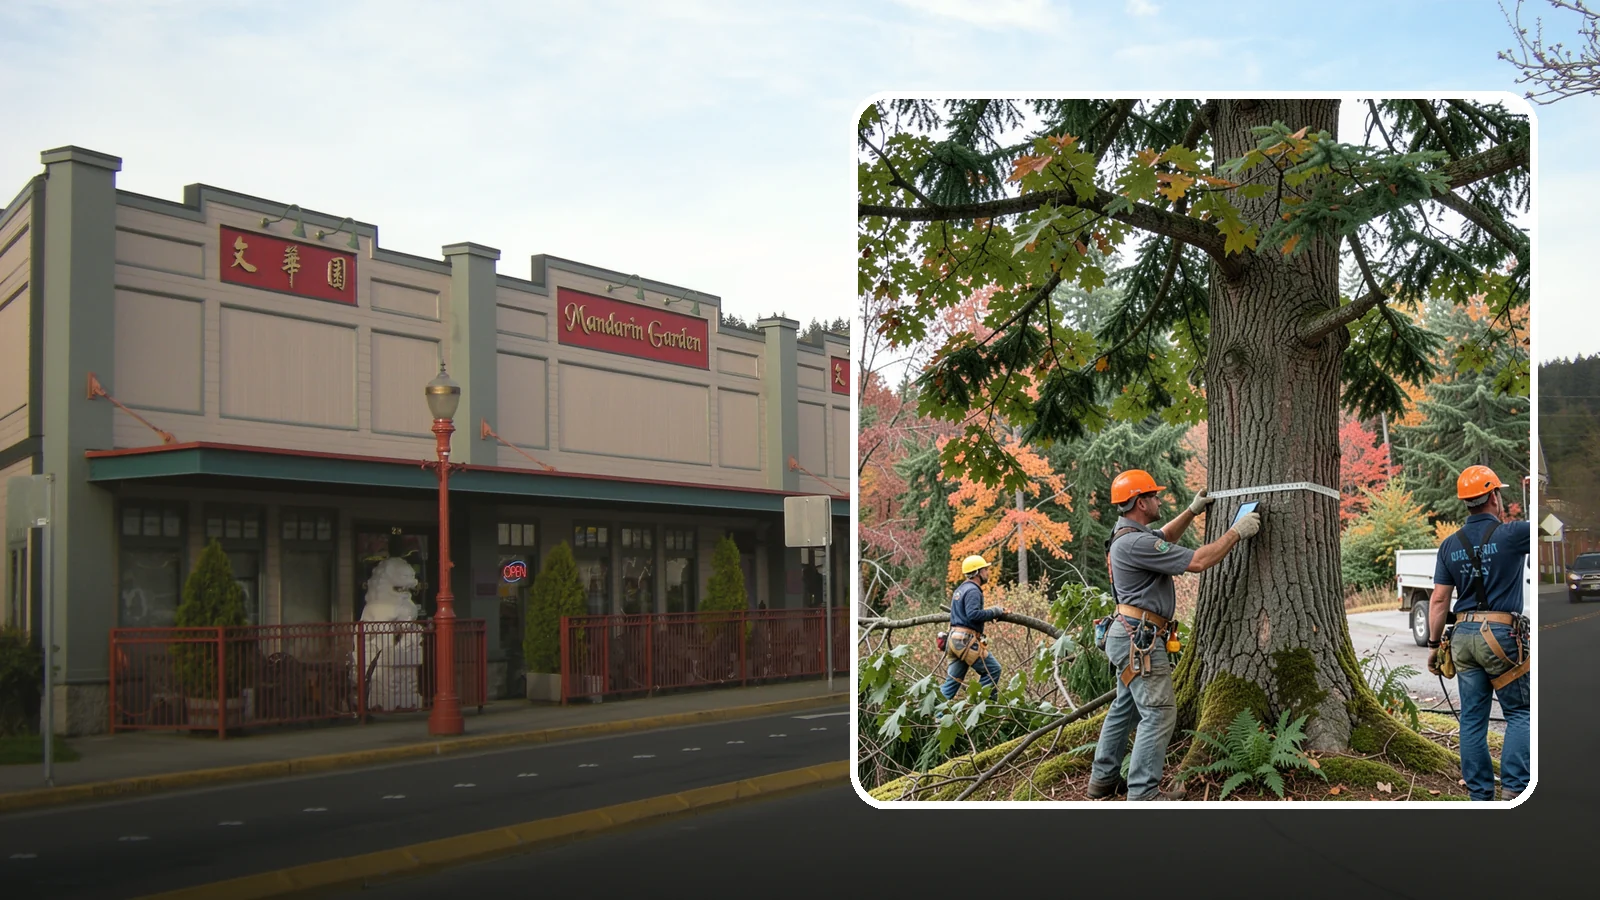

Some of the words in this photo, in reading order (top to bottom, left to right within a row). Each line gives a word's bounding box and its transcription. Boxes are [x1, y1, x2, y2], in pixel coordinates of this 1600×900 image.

[231, 235, 346, 291] 文華園
[564, 302, 644, 341] Mandarin
[648, 320, 702, 352] Garden
[503, 565, 527, 578] OPEN
